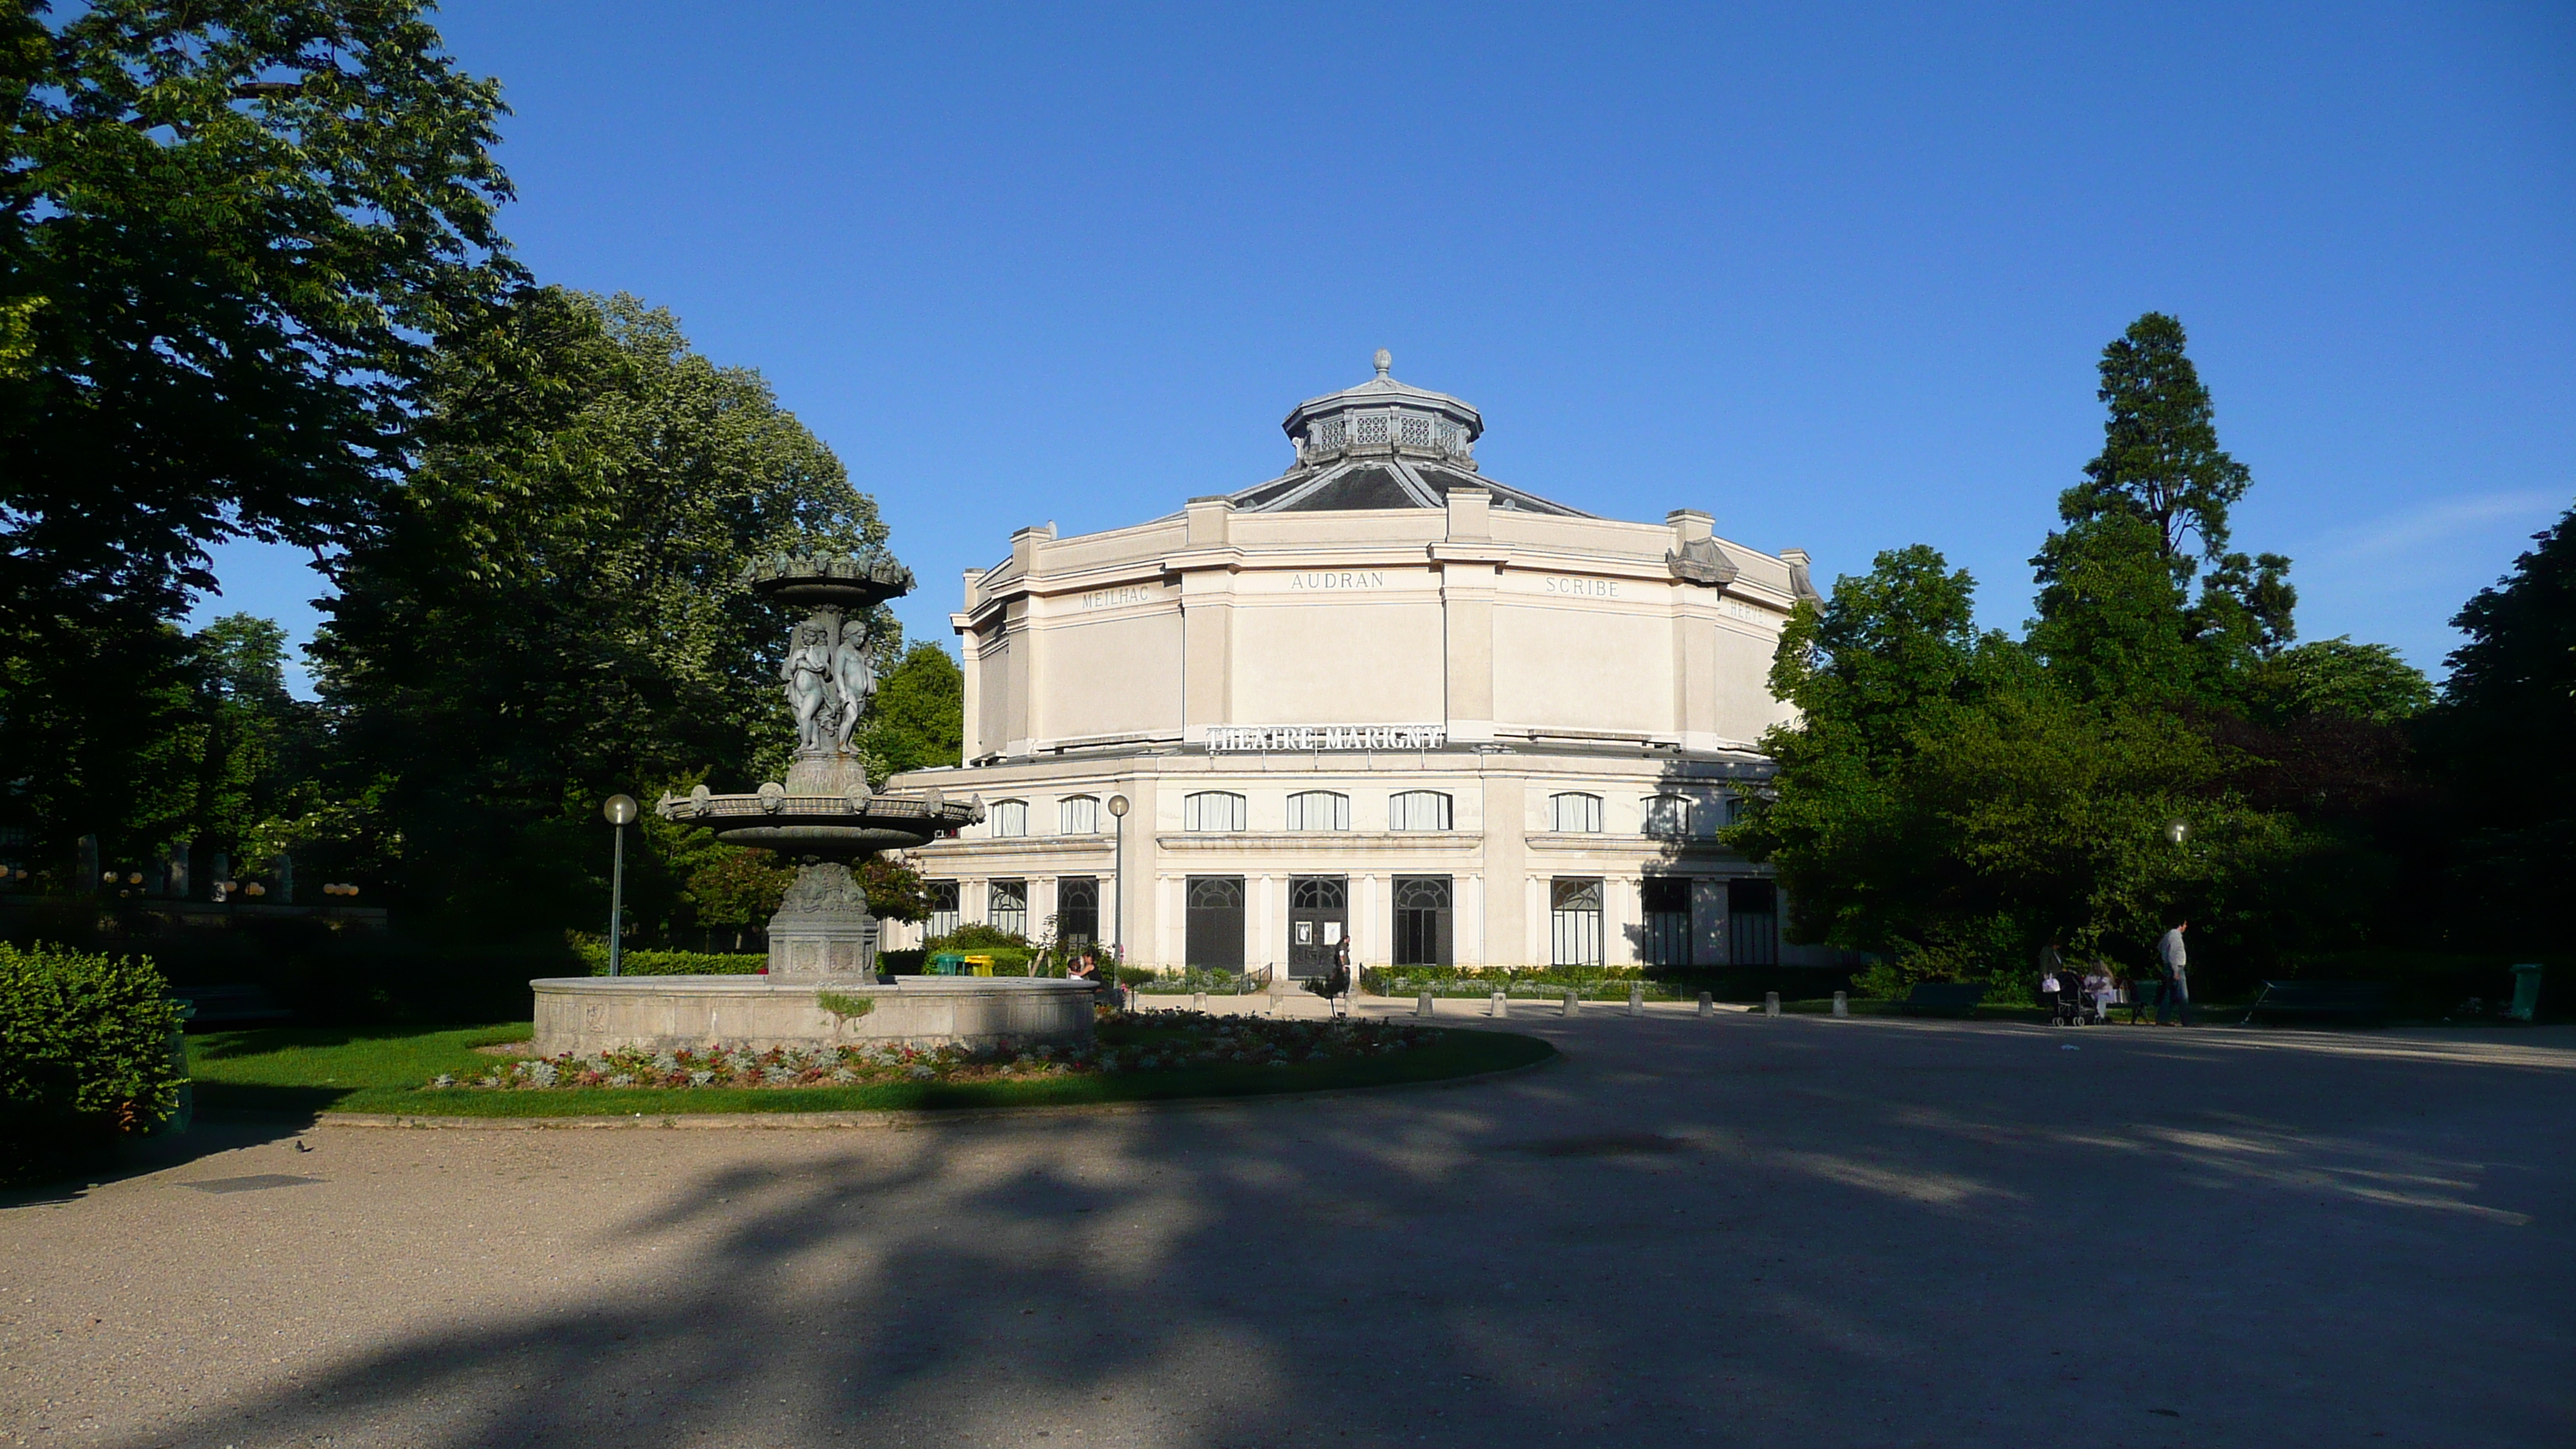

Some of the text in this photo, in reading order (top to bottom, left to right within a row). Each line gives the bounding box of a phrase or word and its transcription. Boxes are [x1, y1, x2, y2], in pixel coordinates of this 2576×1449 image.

[1291, 572, 1383, 589] AUDRAN
[1546, 577, 1619, 597] SCRIBE
[1082, 586, 1149, 608] MEILHAC
[1207, 725, 1443, 751] THEATRE MARIGNY
